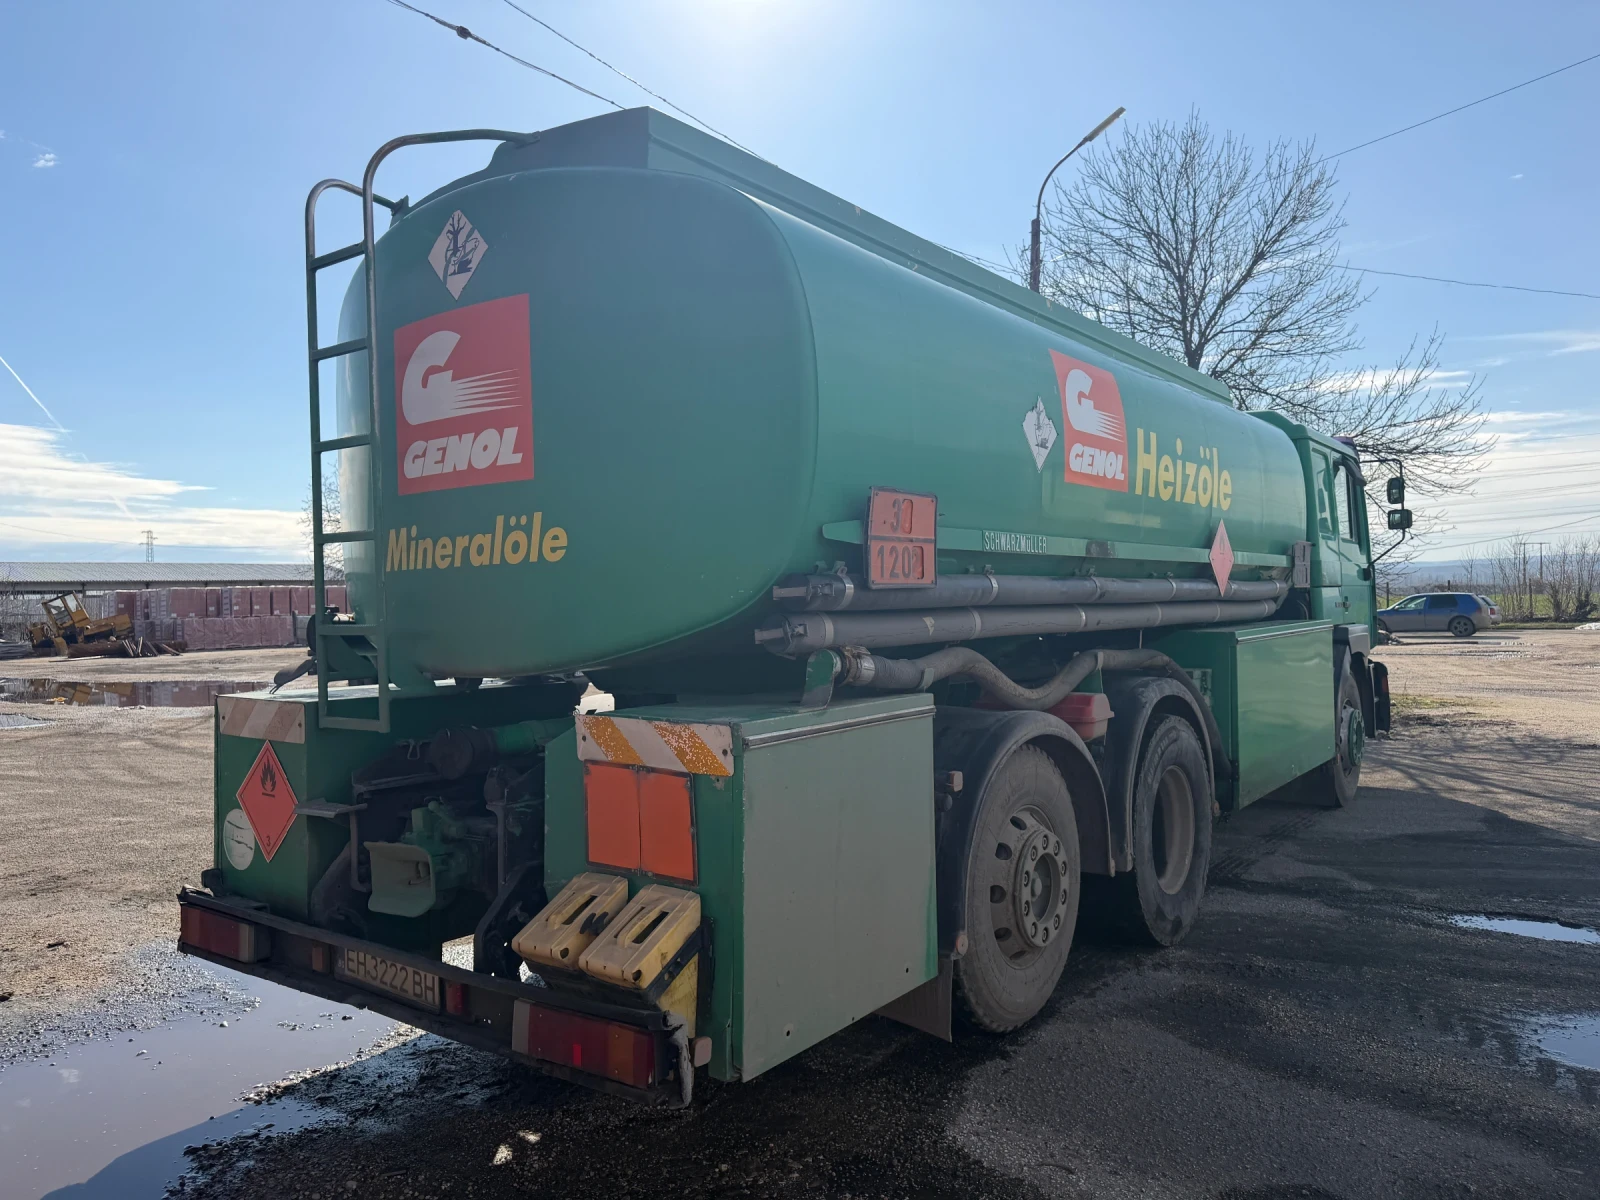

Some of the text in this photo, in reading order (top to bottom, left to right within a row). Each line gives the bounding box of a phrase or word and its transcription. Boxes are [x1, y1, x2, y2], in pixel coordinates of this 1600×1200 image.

[403, 426, 523, 479] GENOL
[1069, 442, 1125, 481] GENOL
[1135, 427, 1233, 511] Heizöle
[386, 511, 568, 572] Mineralöle
[984, 531, 1047, 553] SCHWARZMÜLLER
[265, 835, 271, 847] 3
